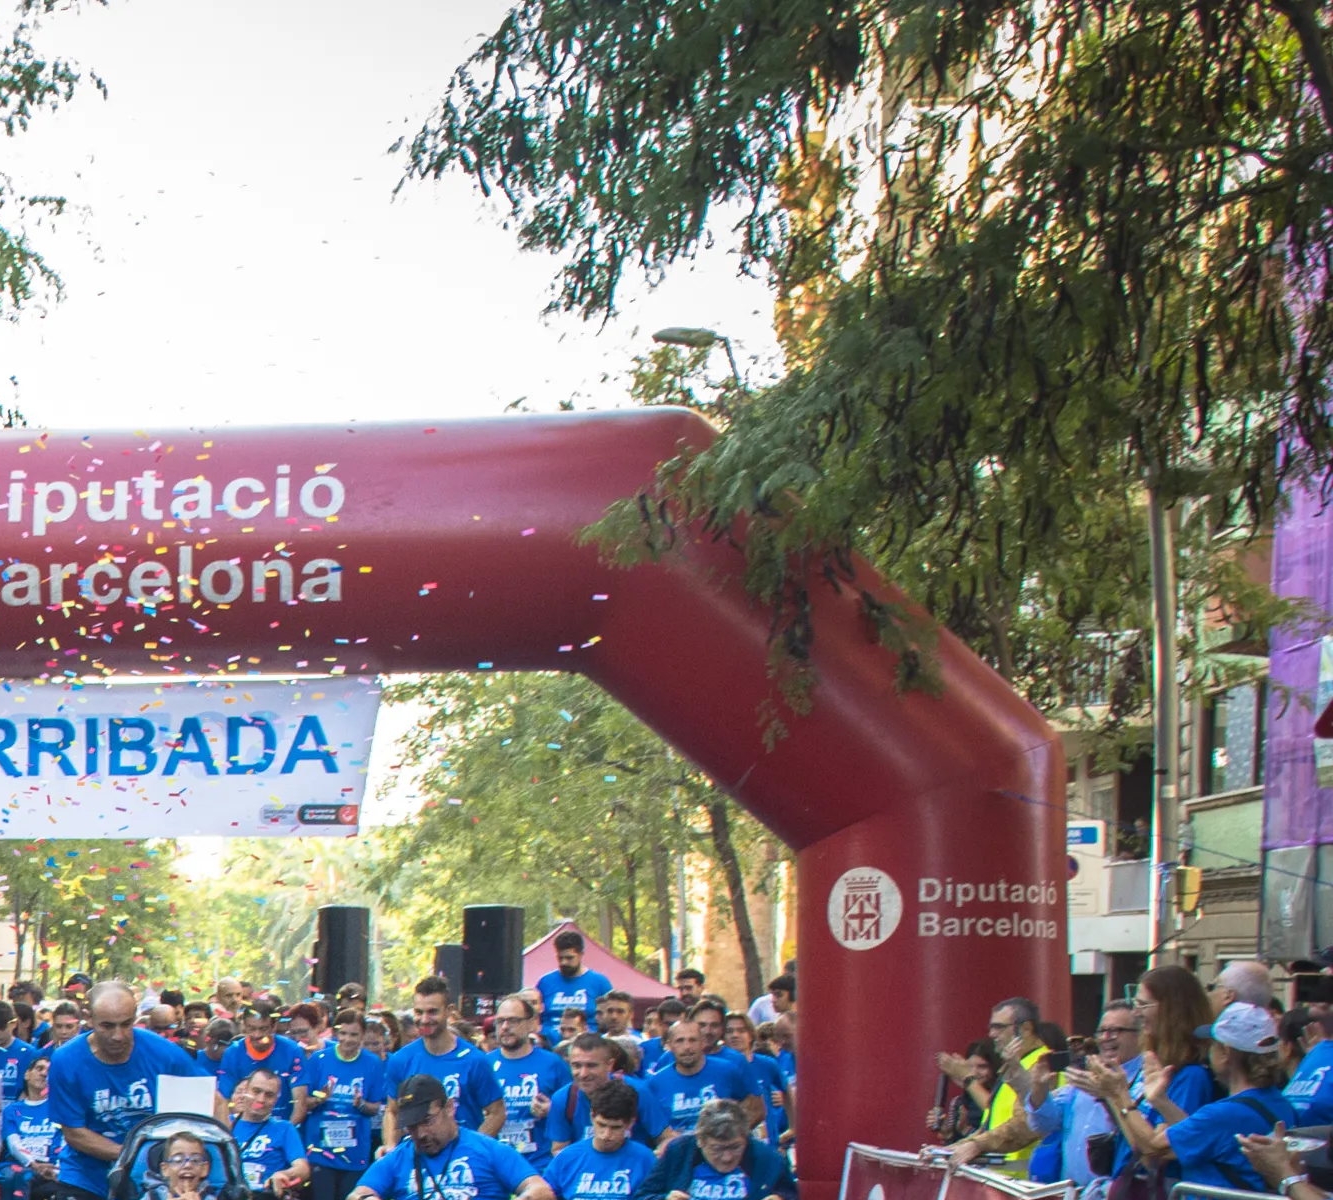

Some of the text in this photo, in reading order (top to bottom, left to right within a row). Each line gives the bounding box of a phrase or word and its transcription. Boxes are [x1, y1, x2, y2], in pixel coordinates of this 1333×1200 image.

[917, 877, 1058, 908] Diputació
[917, 911, 1058, 940] Barcelona
[92, 1093, 153, 1113] MARXA
[576, 1180, 632, 1195] MARXA
